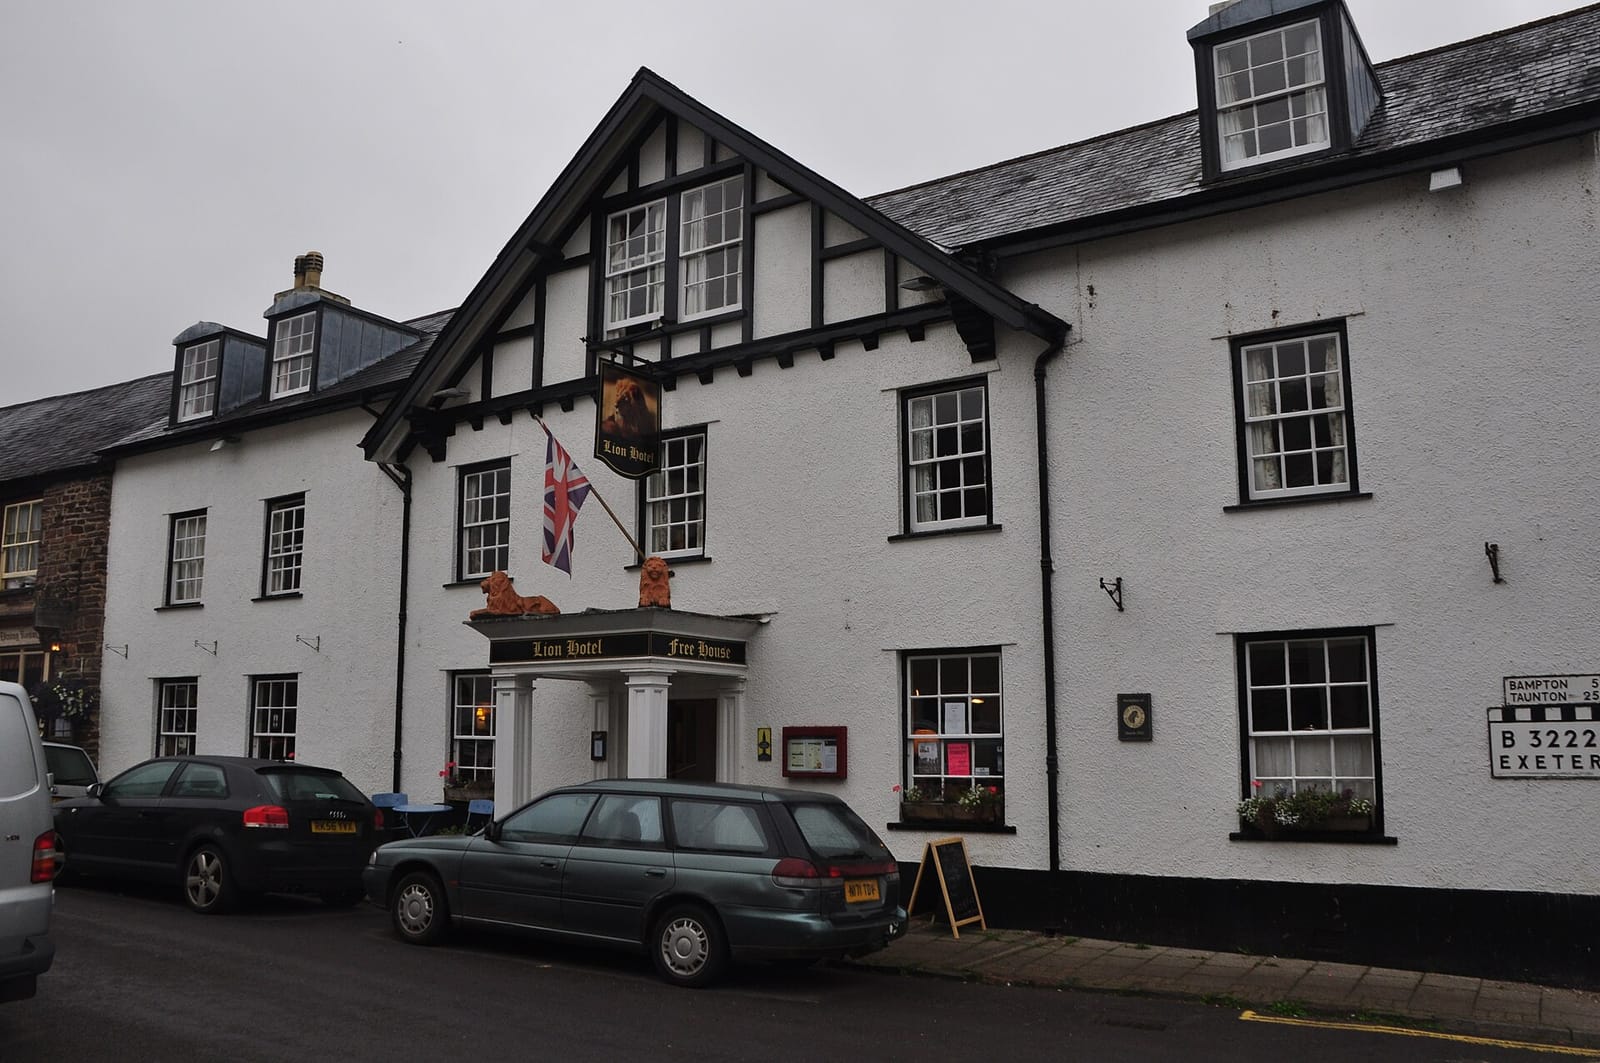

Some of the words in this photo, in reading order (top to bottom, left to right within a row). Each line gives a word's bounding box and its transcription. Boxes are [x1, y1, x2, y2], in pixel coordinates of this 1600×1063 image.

[603, 439, 627, 457] Lion
[630, 446, 655, 465] Hotel
[532, 640, 562, 657] Lion
[567, 638, 603, 659] Hotel
[667, 638, 694, 657] Free
[697, 640, 732, 660] House
[1509, 680, 1568, 690] BAMPTON
[1592, 679, 1599, 688] 5
[1510, 692, 1567, 702] TAUNTON
[1583, 690, 1600, 700] 25
[1502, 730, 1515, 748] B
[1529, 729, 1597, 748] 3222
[1500, 754, 1600, 769] EXETER
